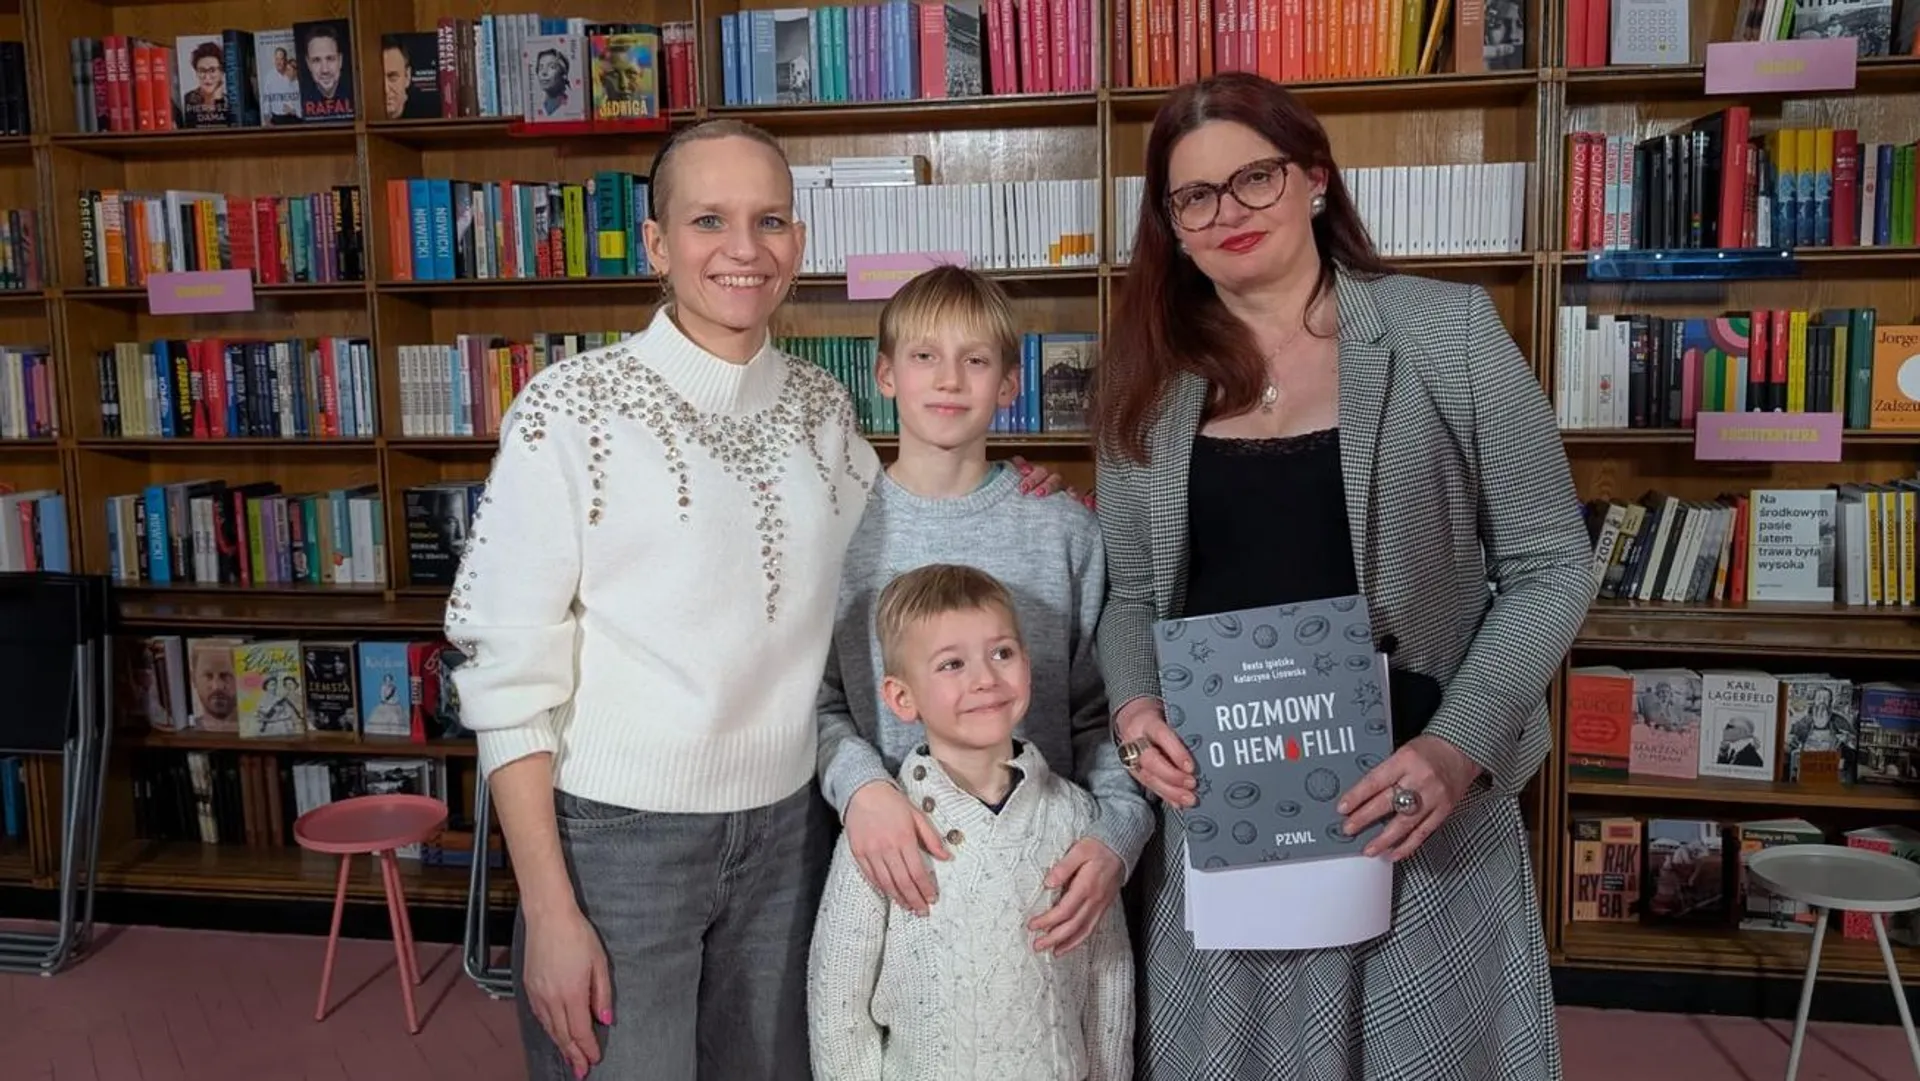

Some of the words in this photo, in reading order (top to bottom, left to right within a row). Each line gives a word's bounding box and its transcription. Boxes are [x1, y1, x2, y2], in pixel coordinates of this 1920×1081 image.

[79, 197, 94, 259] OSIECKA
[415, 207, 427, 258] NOWICKI
[436, 207, 448, 257] NOWICKI
[1878, 332, 1919, 348] Jorge
[1759, 494, 1777, 505] Na
[1758, 505, 1829, 519] środkowym
[1758, 520, 1792, 533] pasie
[1758, 532, 1793, 544] latem
[1757, 547, 1792, 557] trawa
[1794, 546, 1821, 560] była
[1757, 559, 1805, 571] wysoka
[1242, 660, 1263, 672] Beata
[1233, 672, 1270, 686] Katarzyna
[1272, 667, 1306, 681] Lisowska
[1726, 680, 1757, 691] KARL
[1708, 691, 1775, 704] LAGERFELD
[1216, 692, 1336, 731] ROZMOWY
[1209, 742, 1225, 768] O
[1275, 831, 1316, 847] PZWL
[1603, 844, 1638, 873] RAK
[1599, 893, 1622, 919] BA
